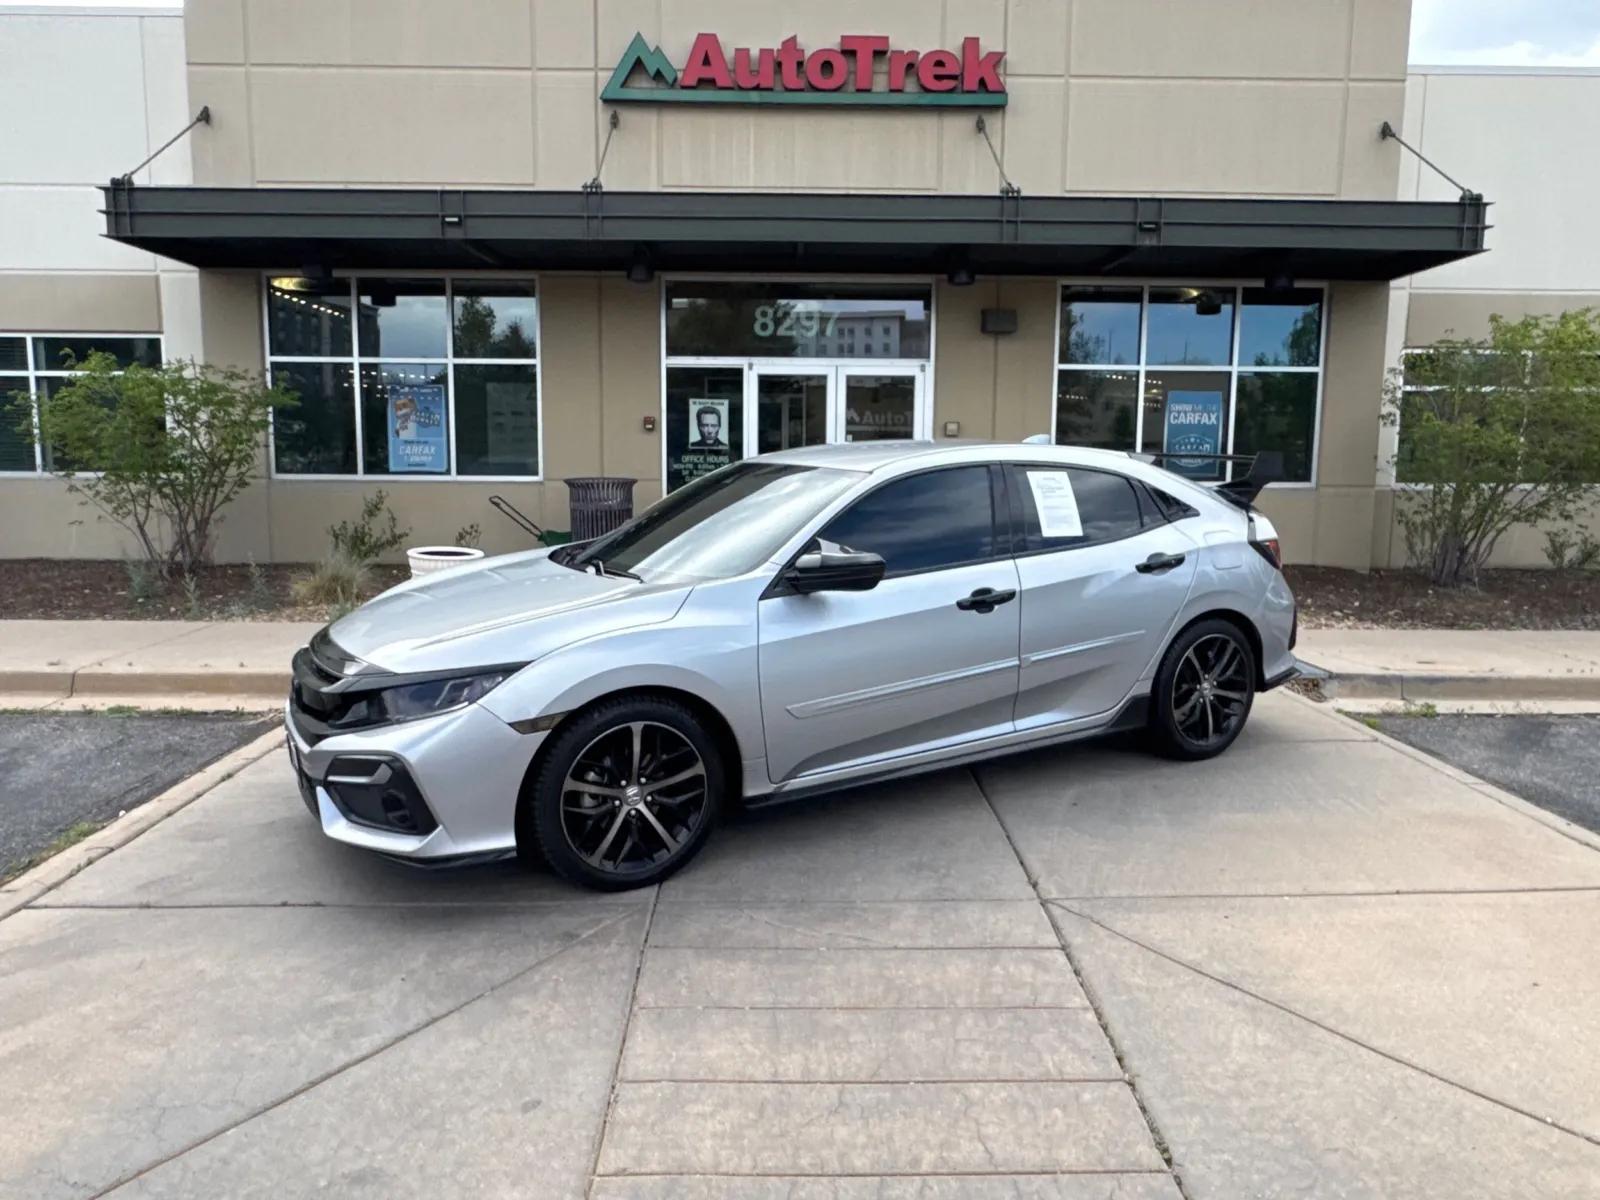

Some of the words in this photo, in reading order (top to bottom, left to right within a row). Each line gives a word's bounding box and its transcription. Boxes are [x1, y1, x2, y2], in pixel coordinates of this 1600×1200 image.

[680, 32, 1006, 93] AutoTrek
[753, 305, 840, 337] 8297
[1170, 412, 1217, 425] CARFAX
[682, 455, 704, 463] OFFICE
[706, 455, 729, 463] HOURS
